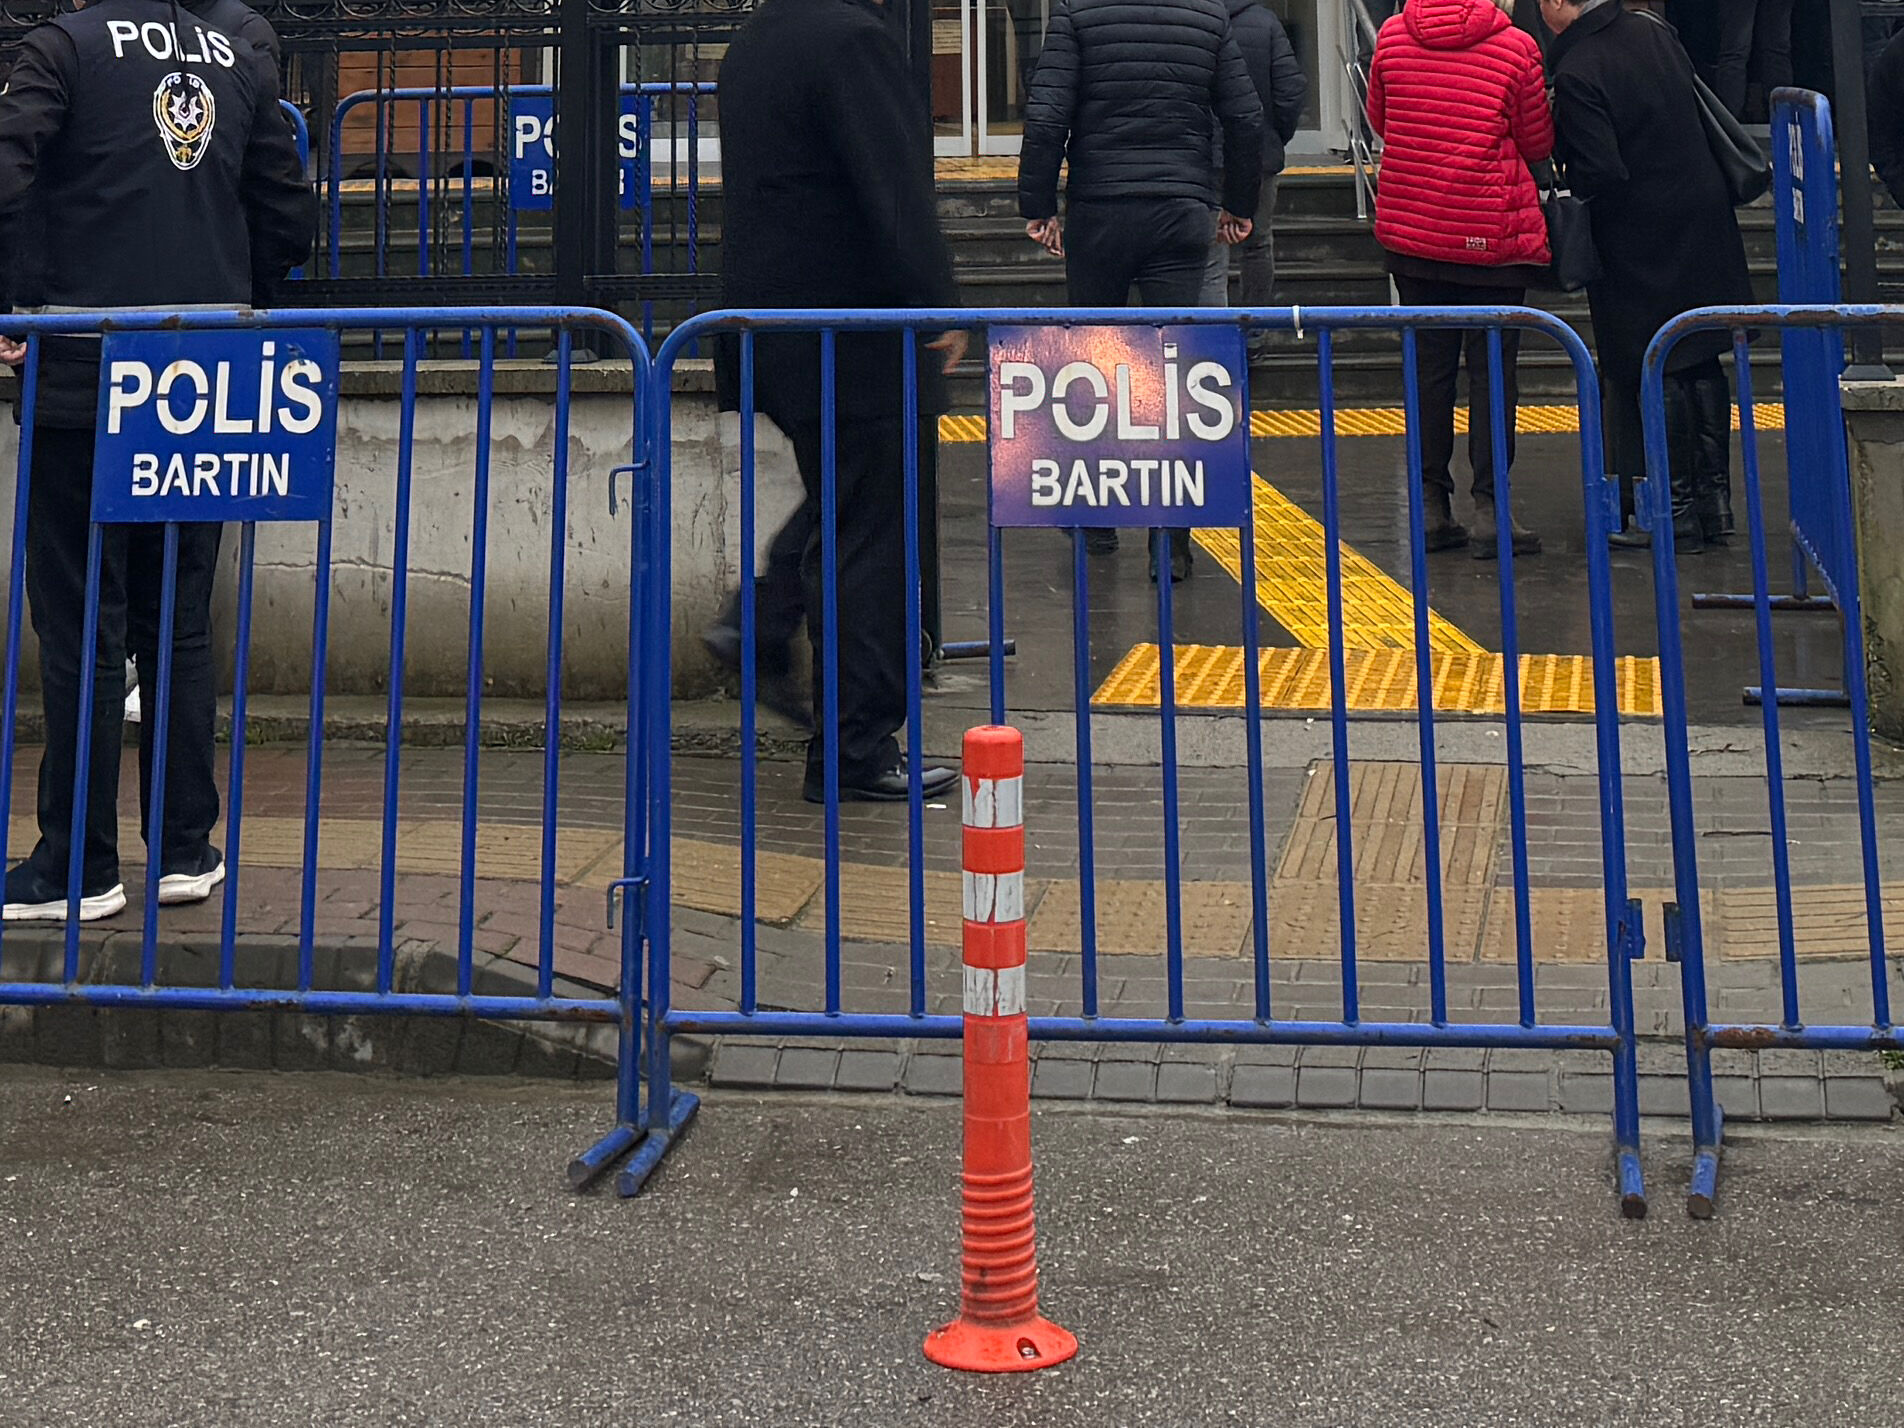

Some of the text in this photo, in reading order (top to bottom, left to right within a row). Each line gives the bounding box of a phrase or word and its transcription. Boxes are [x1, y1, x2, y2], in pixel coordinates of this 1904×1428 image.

[106, 20, 235, 68] POLİS
[107, 341, 322, 434] POLİS
[999, 342, 1234, 442] POLİS
[131, 453, 290, 497] BARTIN
[1031, 458, 1205, 507] BARTIN
